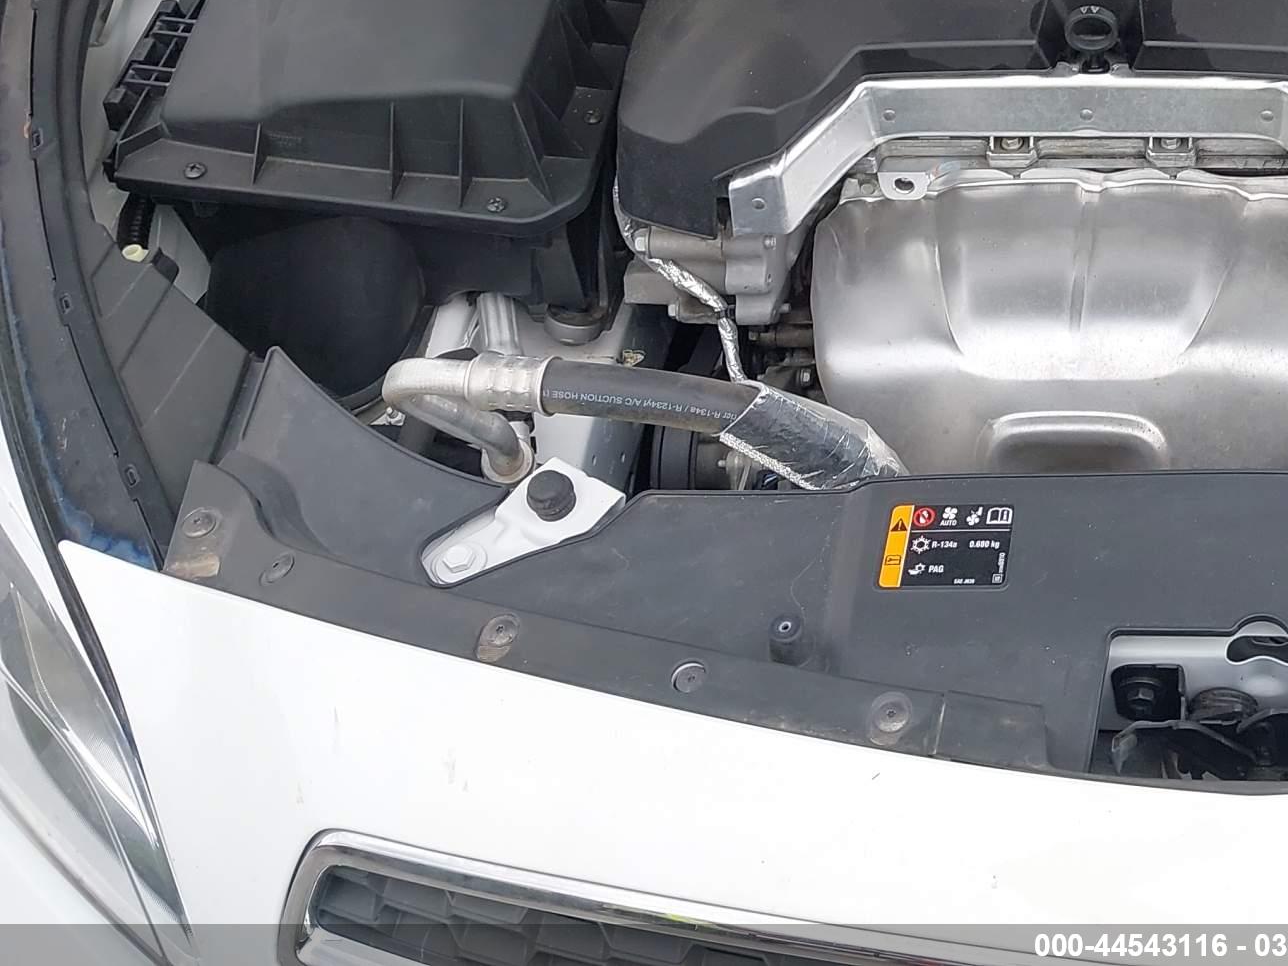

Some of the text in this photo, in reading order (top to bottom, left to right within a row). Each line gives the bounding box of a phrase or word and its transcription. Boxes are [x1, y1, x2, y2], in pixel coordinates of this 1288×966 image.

[552, 390, 580, 401] HOSE
[581, 393, 623, 406] SUCTION
[624, 396, 641, 407] A/C
[642, 399, 682, 412] R-1234yf
[689, 405, 721, 419] R-134a
[990, 540, 1001, 550] kg
[928, 565, 945, 573] PAG
